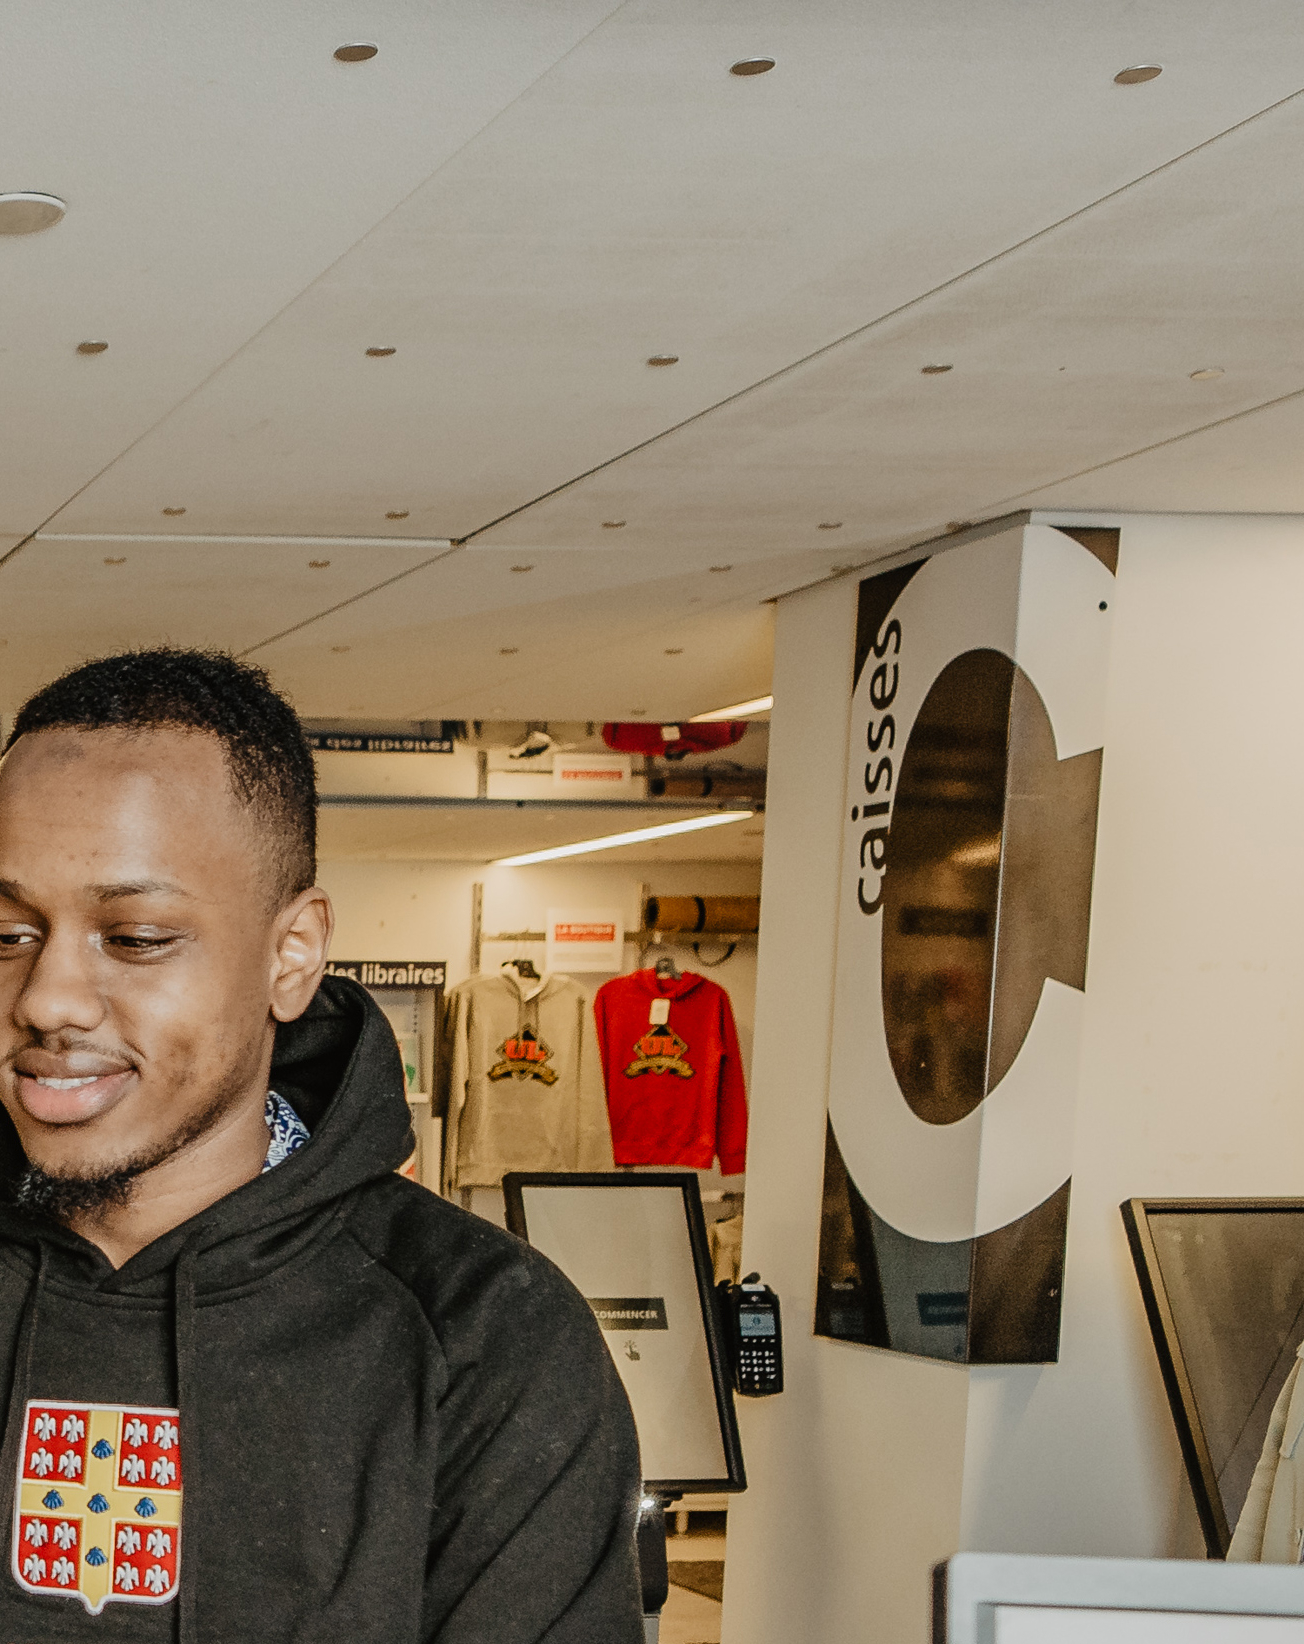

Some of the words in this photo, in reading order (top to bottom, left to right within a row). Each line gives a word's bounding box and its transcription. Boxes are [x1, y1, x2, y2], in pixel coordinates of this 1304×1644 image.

[851, 618, 902, 916] caisses
[360, 962, 446, 985] libraires
[594, 1309, 658, 1320] COMMENCER
